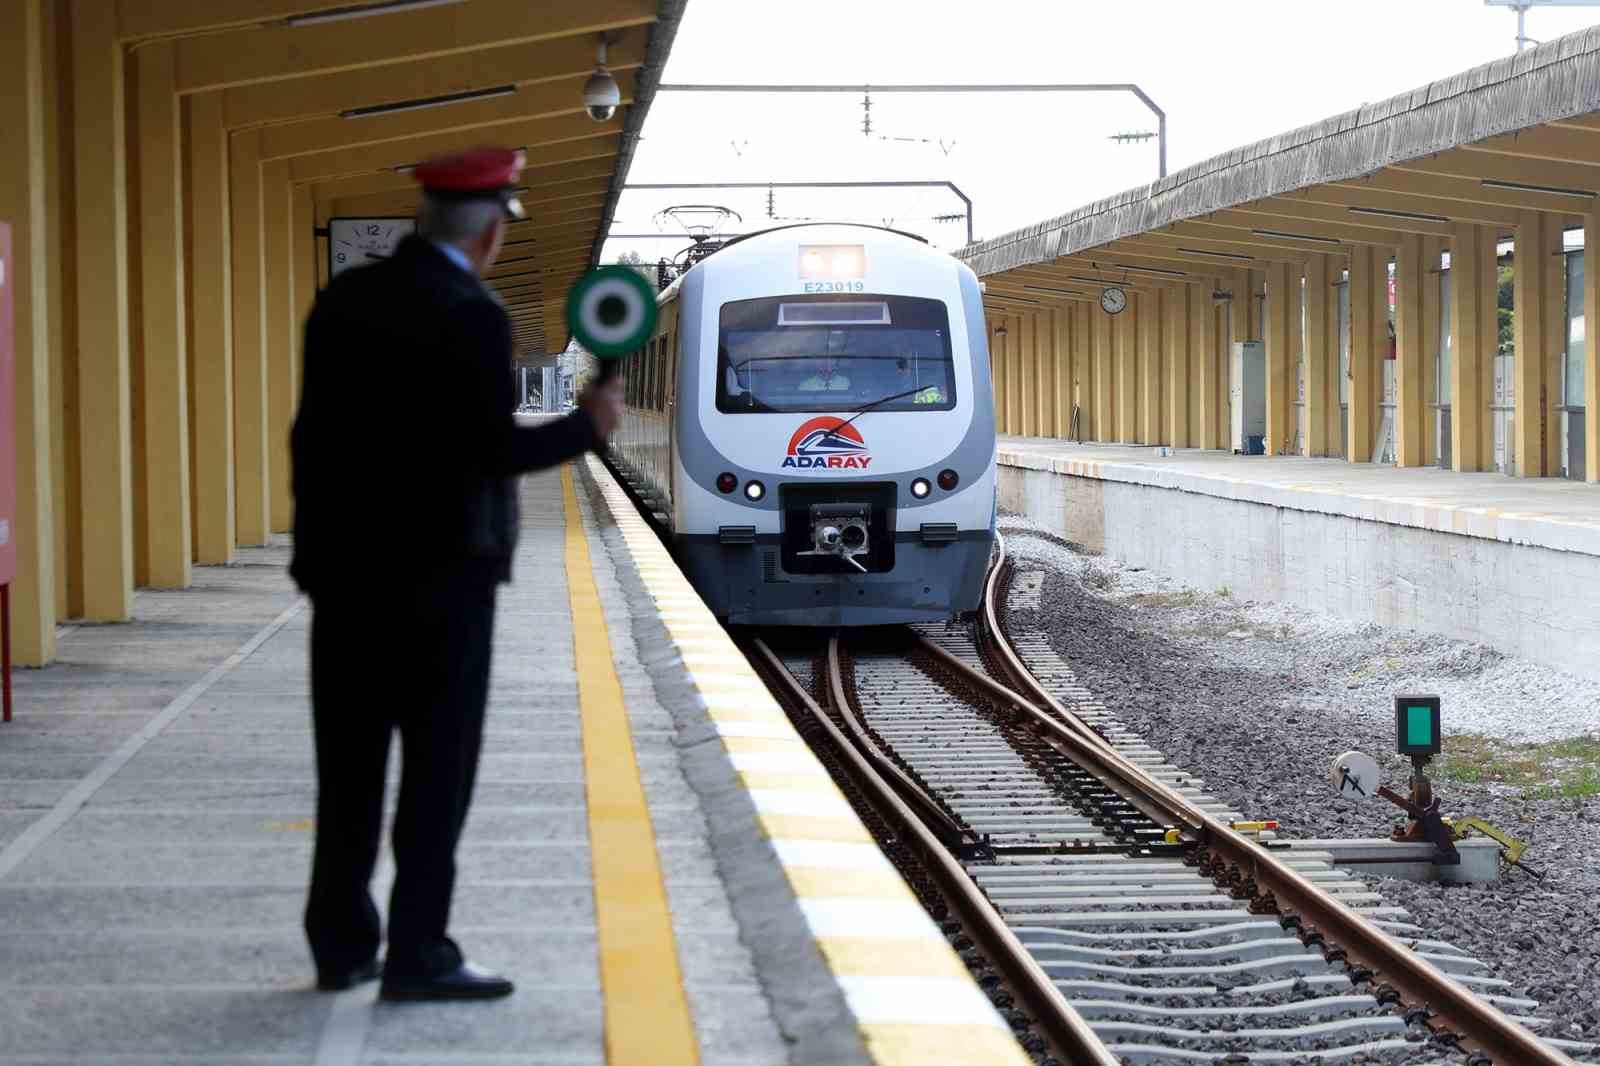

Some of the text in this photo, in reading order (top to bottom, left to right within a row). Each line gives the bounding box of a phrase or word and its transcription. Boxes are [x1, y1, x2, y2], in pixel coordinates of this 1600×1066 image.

[367, 224, 380, 236] 12
[336, 252, 346, 264] 9
[804, 281, 864, 293] E23019
[781, 456, 872, 469] ADARAY
